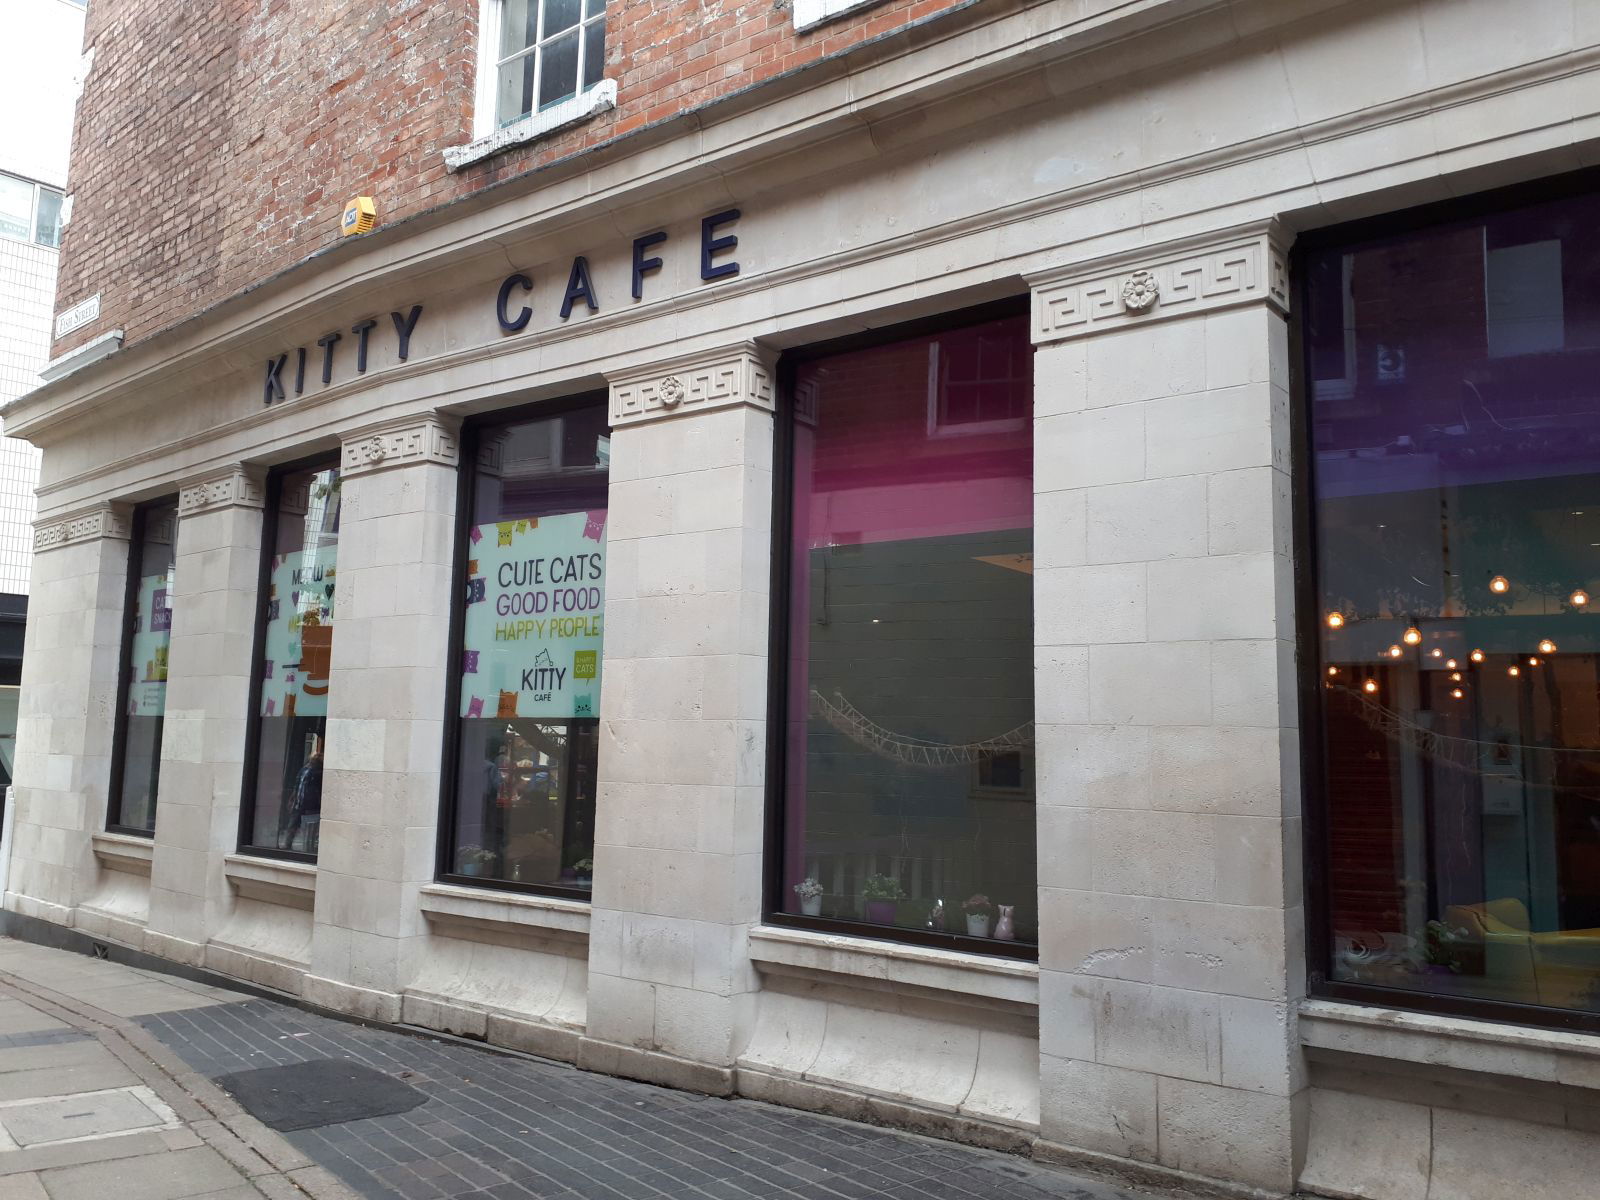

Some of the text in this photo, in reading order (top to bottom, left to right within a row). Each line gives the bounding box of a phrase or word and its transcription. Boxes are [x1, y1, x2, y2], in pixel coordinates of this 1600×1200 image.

[263, 208, 741, 403] KITTY CAFE
[498, 553, 602, 588] CUTE CATS
[496, 587, 601, 616] GOOD FOOD
[495, 616, 600, 641] HAPPY PEOPLE
[521, 667, 567, 691] KITTY
[575, 664, 594, 674] CATS
[534, 691, 552, 702] CAFÉ
